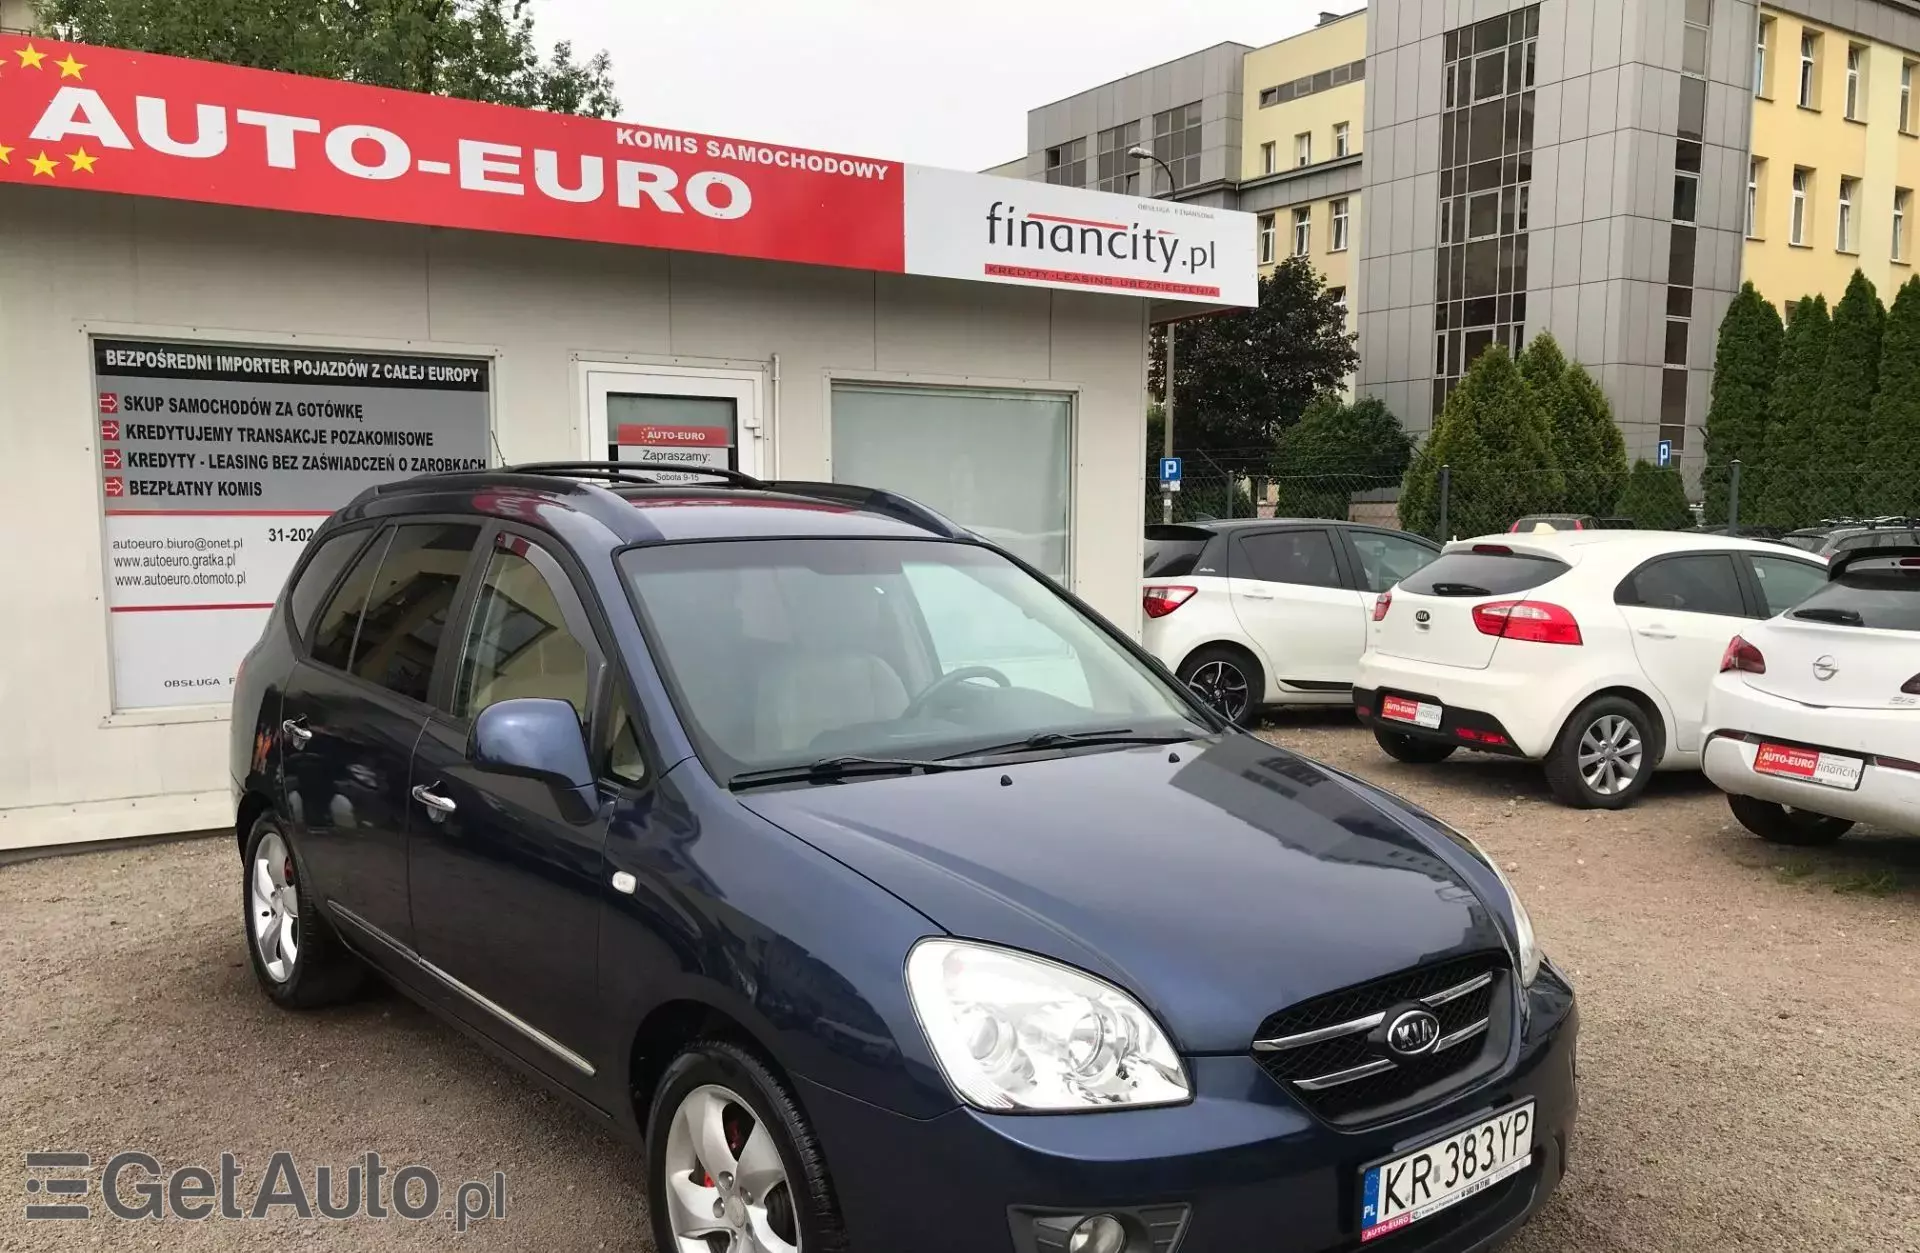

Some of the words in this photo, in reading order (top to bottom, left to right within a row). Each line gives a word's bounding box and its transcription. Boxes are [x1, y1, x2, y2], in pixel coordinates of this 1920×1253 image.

[28, 85, 752, 220] AUTO-EURO
[616, 127, 698, 154] KOMIS
[706, 140, 889, 181] SAMOCHODOWY
[986, 201, 1215, 274] financity.pl
[106, 348, 212, 370] BEZPOŚREDNI
[217, 355, 290, 374] IMPORTER
[293, 359, 368, 378] POJAZDÓW
[371, 363, 380, 378] Z
[384, 364, 424, 380] CAŁEJ
[428, 366, 479, 382] EUROPY
[124, 395, 164, 412] SKUP
[168, 397, 271, 416] SAMOCHODÓW
[275, 401, 293, 416] ZA
[297, 400, 363, 422] GOTÓWKĘ
[126, 423, 233, 442] KREDYTUJEMY
[237, 427, 327, 444] TRANSAKCJE
[331, 430, 433, 446] POZAKOMISOWE
[647, 430, 706, 441] AUTO-EURO
[127, 452, 196, 468] KREDYTY
[208, 454, 268, 470] LEASING
[272, 455, 298, 470] BEZ
[302, 452, 394, 471] ZAŚWIADCZEŃ
[398, 456, 408, 471] O
[411, 457, 486, 471] ZAROBKACH
[642, 449, 711, 463] Zapraszamy:
[655, 472, 682, 481] Sobota
[683, 473, 699, 481] 9-15
[1165, 460, 1177, 478] P
[129, 480, 214, 496] BEZPŁATNY
[217, 481, 263, 496] KOMIS
[112, 537, 243, 551] autoeuro.biuro@onet.pl
[268, 528, 314, 542] 31-202
[113, 553, 236, 569] www.autoeuro.gratka.pl
[115, 571, 246, 587] www.autoeuro.otomoto.pl
[164, 678, 221, 688] OBSŁUGA
[1762, 751, 1815, 769] AUTO-EURO
[1396, 1018, 1434, 1049] KIA
[1384, 1153, 1432, 1215] KR
[1444, 1109, 1529, 1188] 383YP
[1363, 1203, 1376, 1219] PL
[1366, 1216, 1409, 1239] AUTO-EURO
